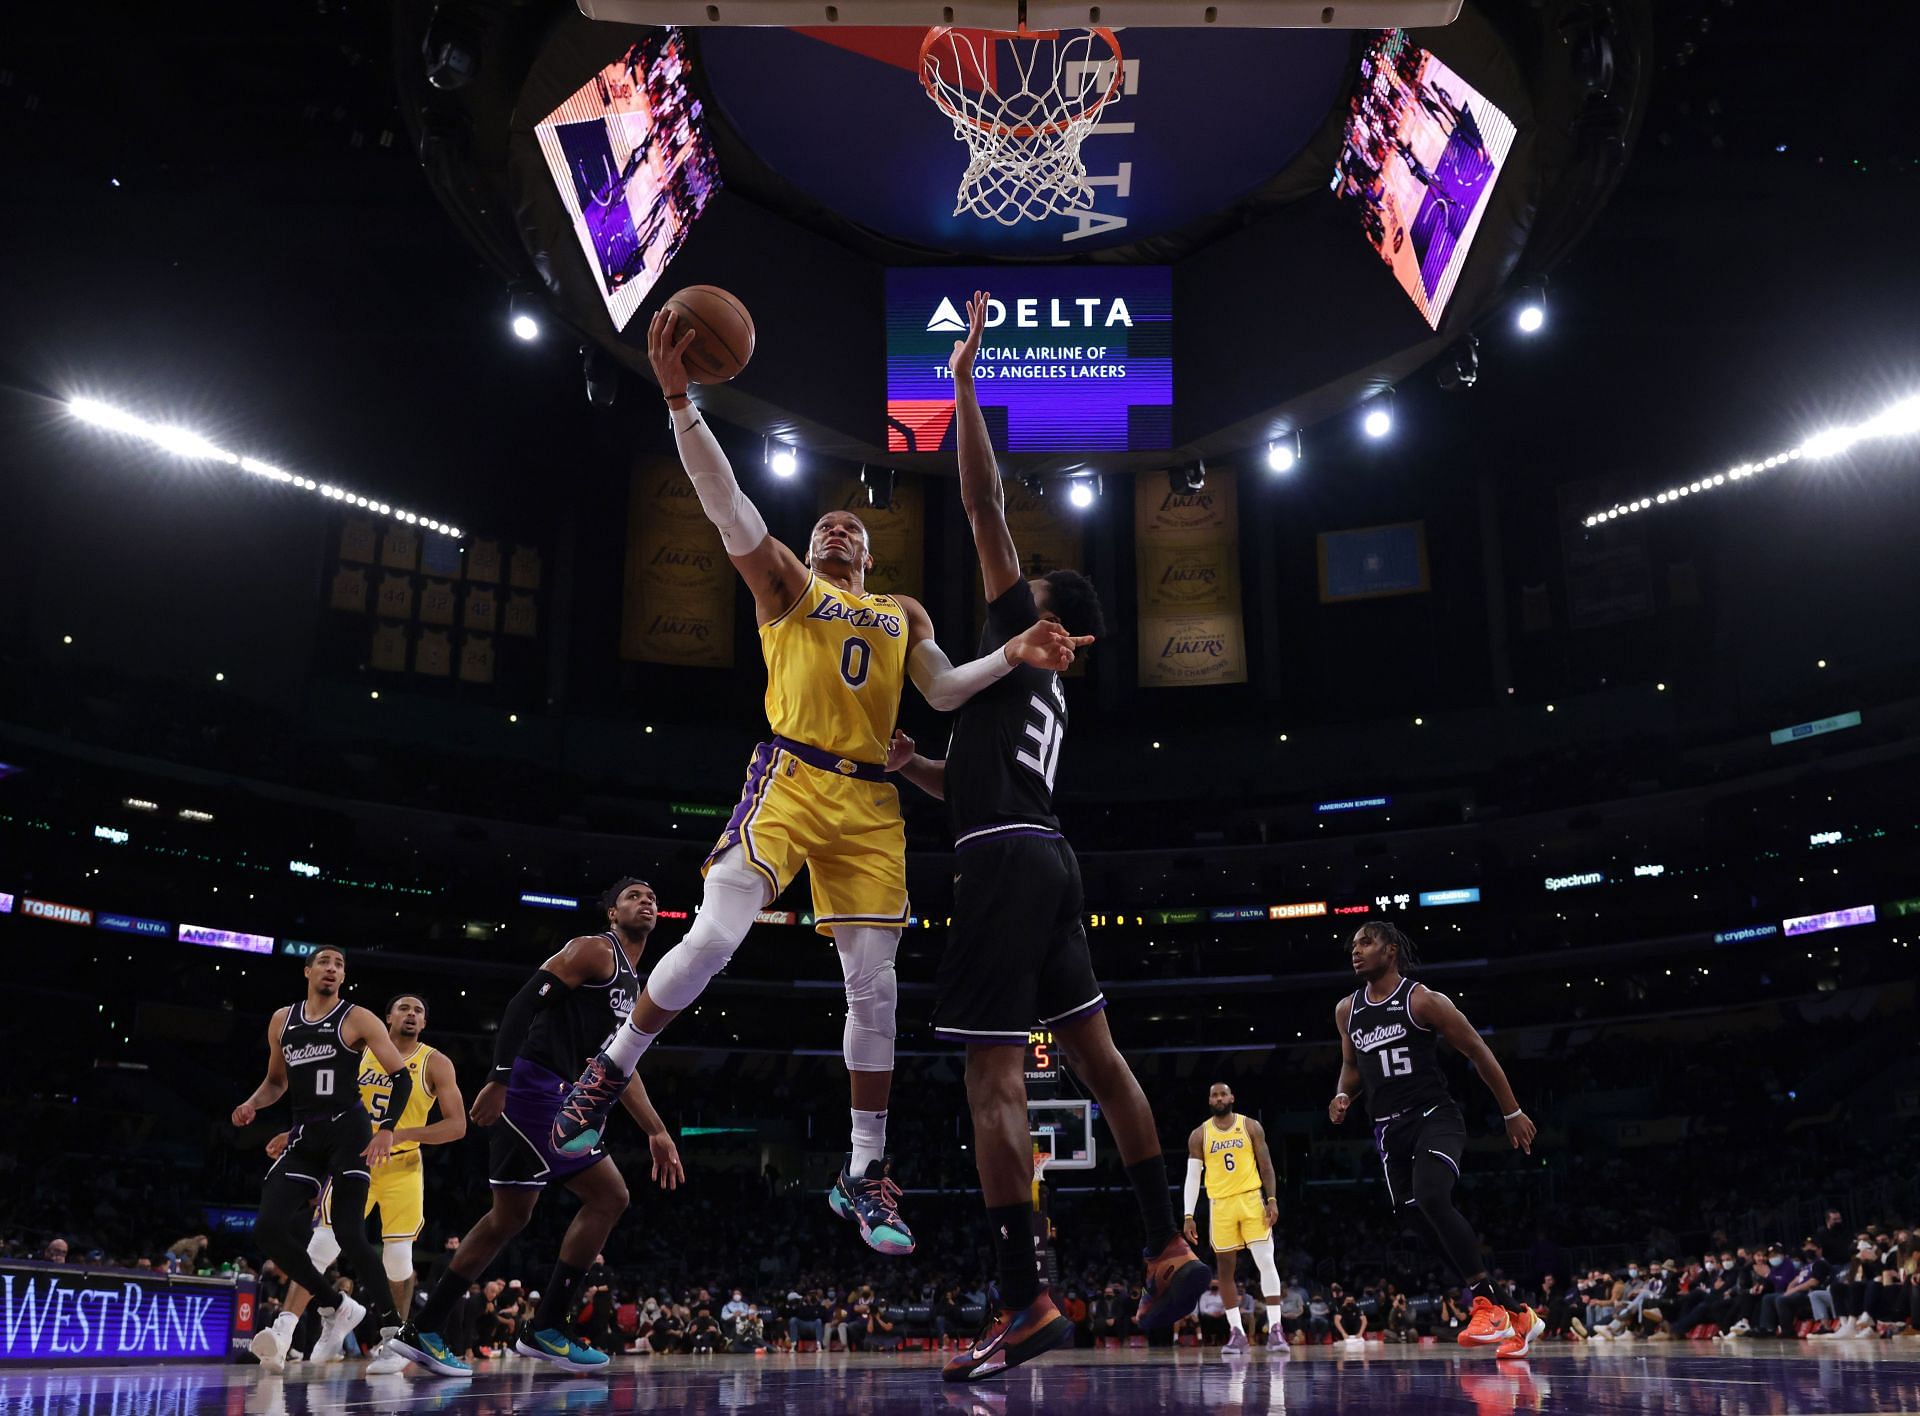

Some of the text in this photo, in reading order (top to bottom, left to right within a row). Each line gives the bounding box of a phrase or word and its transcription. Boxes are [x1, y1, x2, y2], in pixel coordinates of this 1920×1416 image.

[983, 298, 1133, 327] DELTA
[1025, 347, 1081, 360] AIRLINE
[1086, 346, 1107, 359] OF
[1000, 365, 1066, 379] ANGELES
[1071, 364, 1126, 378] LAKERS
[807, 593, 901, 638] LAKERS
[840, 637, 871, 690] 0
[1319, 798, 1386, 811] AMERICAN EXPRESS
[290, 860, 321, 877] bibigo
[1545, 873, 1601, 891] Spectrum
[521, 894, 577, 907] AMERICAN EXPRESS
[23, 899, 91, 925] TOSHIBA
[1240, 910, 1264, 918] ULTRA
[1271, 903, 1326, 918] TOSHIBA
[136, 921, 166, 933] ULTRA
[1724, 924, 1777, 942] crypto.com
[1351, 1023, 1407, 1052] Sactown
[282, 1043, 338, 1067] Sactown
[1035, 1044, 1049, 1068] 5
[1379, 1047, 1412, 1077] 15
[316, 1069, 335, 1096] 0
[1023, 1071, 1057, 1079] TISSOT
[1210, 1138, 1244, 1154] LAKERS
[1223, 1152, 1236, 1172] 6
[1, 1274, 214, 1354] WEST BANK
